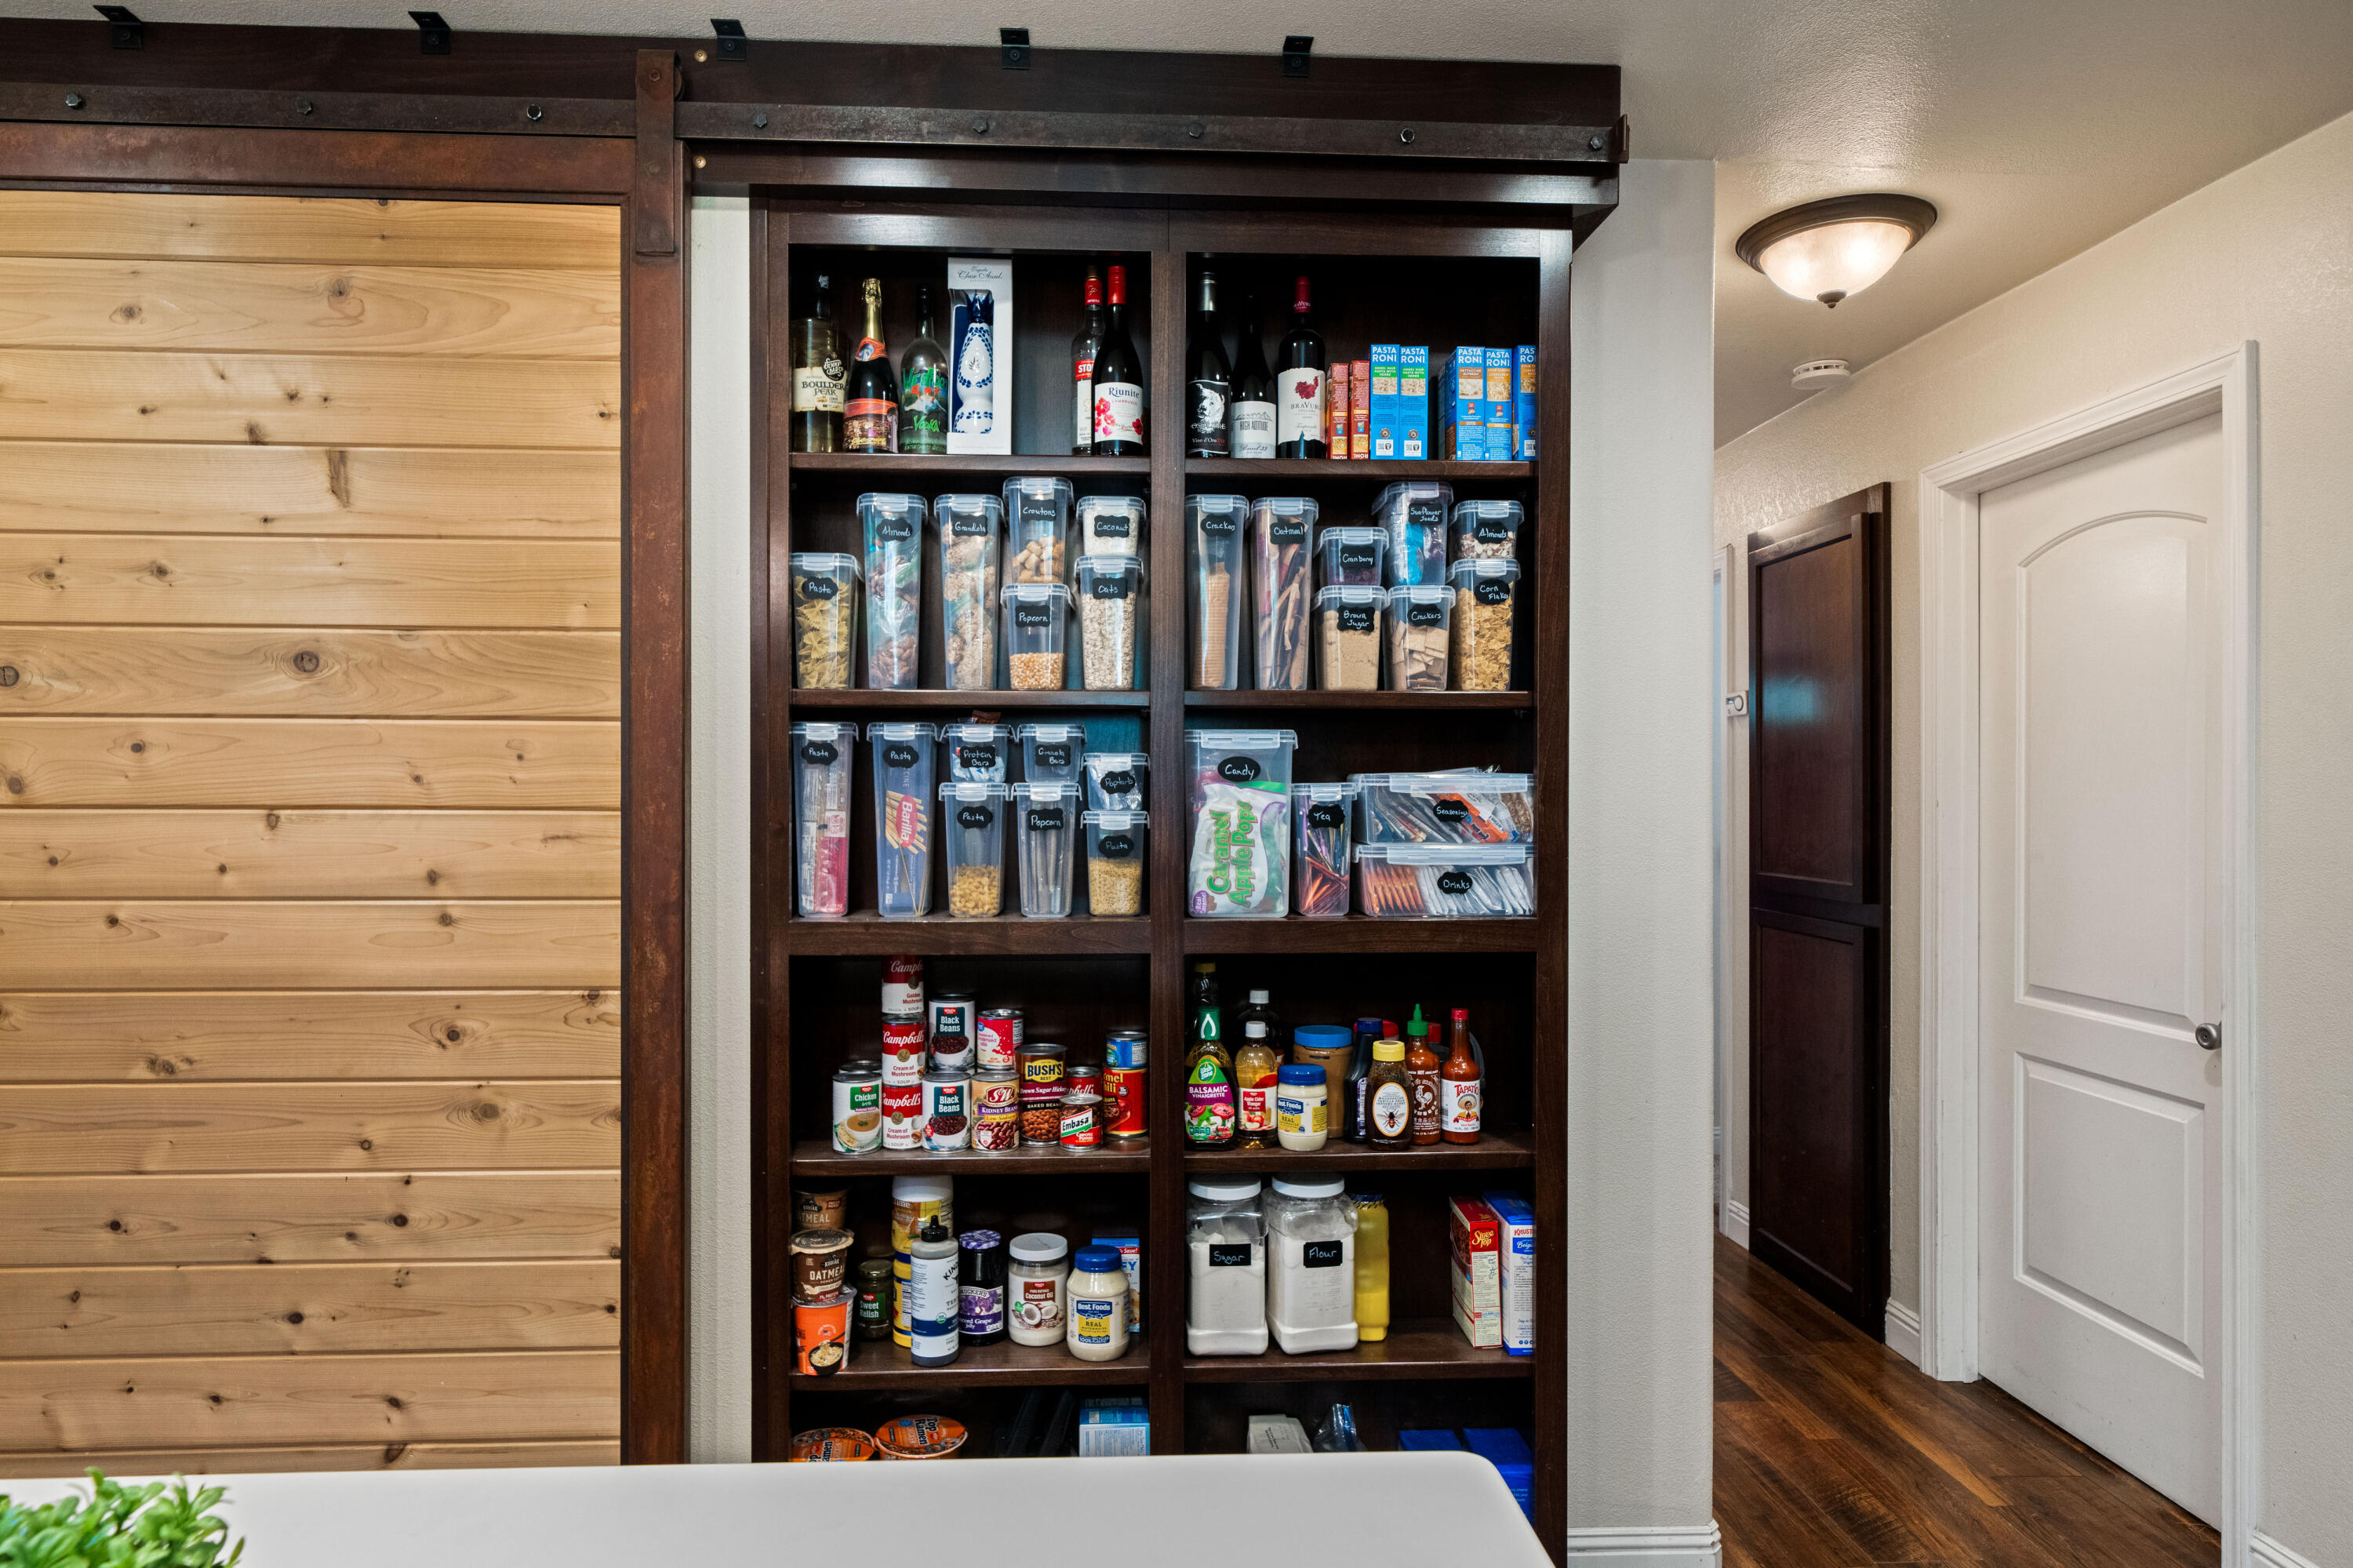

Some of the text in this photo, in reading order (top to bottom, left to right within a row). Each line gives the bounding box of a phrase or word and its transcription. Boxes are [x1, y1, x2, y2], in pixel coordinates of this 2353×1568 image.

[802, 381, 846, 390] BOULDER
[1108, 387, 1140, 398] Riunite
[1022, 507, 1056, 517] Croutons
[882, 525, 911, 537] Almonds
[1096, 522, 1129, 532] Coconut
[1273, 526, 1304, 536] Oatmeal
[809, 583, 832, 594] Pasta
[1098, 584, 1118, 594] Oats
[1479, 584, 1498, 593] Corn
[1018, 612, 1049, 623] Popcorn
[1411, 612, 1442, 620] Crackers
[890, 751, 911, 761] Pasta
[963, 749, 992, 759] Protein
[1224, 764, 1255, 780] Candy
[900, 799, 914, 842] Barilla
[962, 812, 984, 821] Pasta
[1031, 816, 1061, 828] Popcorn
[1105, 841, 1128, 850] Pasta
[1206, 809, 1231, 894] Caramel
[1227, 799, 1259, 908] Apple Pops
[1442, 879, 1470, 890] Drinks
[1027, 1063, 1062, 1077] BUSH'S
[938, 1104, 960, 1112] Beans
[1063, 1116, 1089, 1131] Embasa
[1471, 1228, 1495, 1245] Stove
[1480, 1239, 1493, 1248] Top
[1213, 1251, 1245, 1264] Sugar
[1309, 1247, 1337, 1258] Flour
[809, 1266, 846, 1280] OATMEAL
[926, 1417, 940, 1432] Top
[915, 1418, 928, 1446] Ramen
